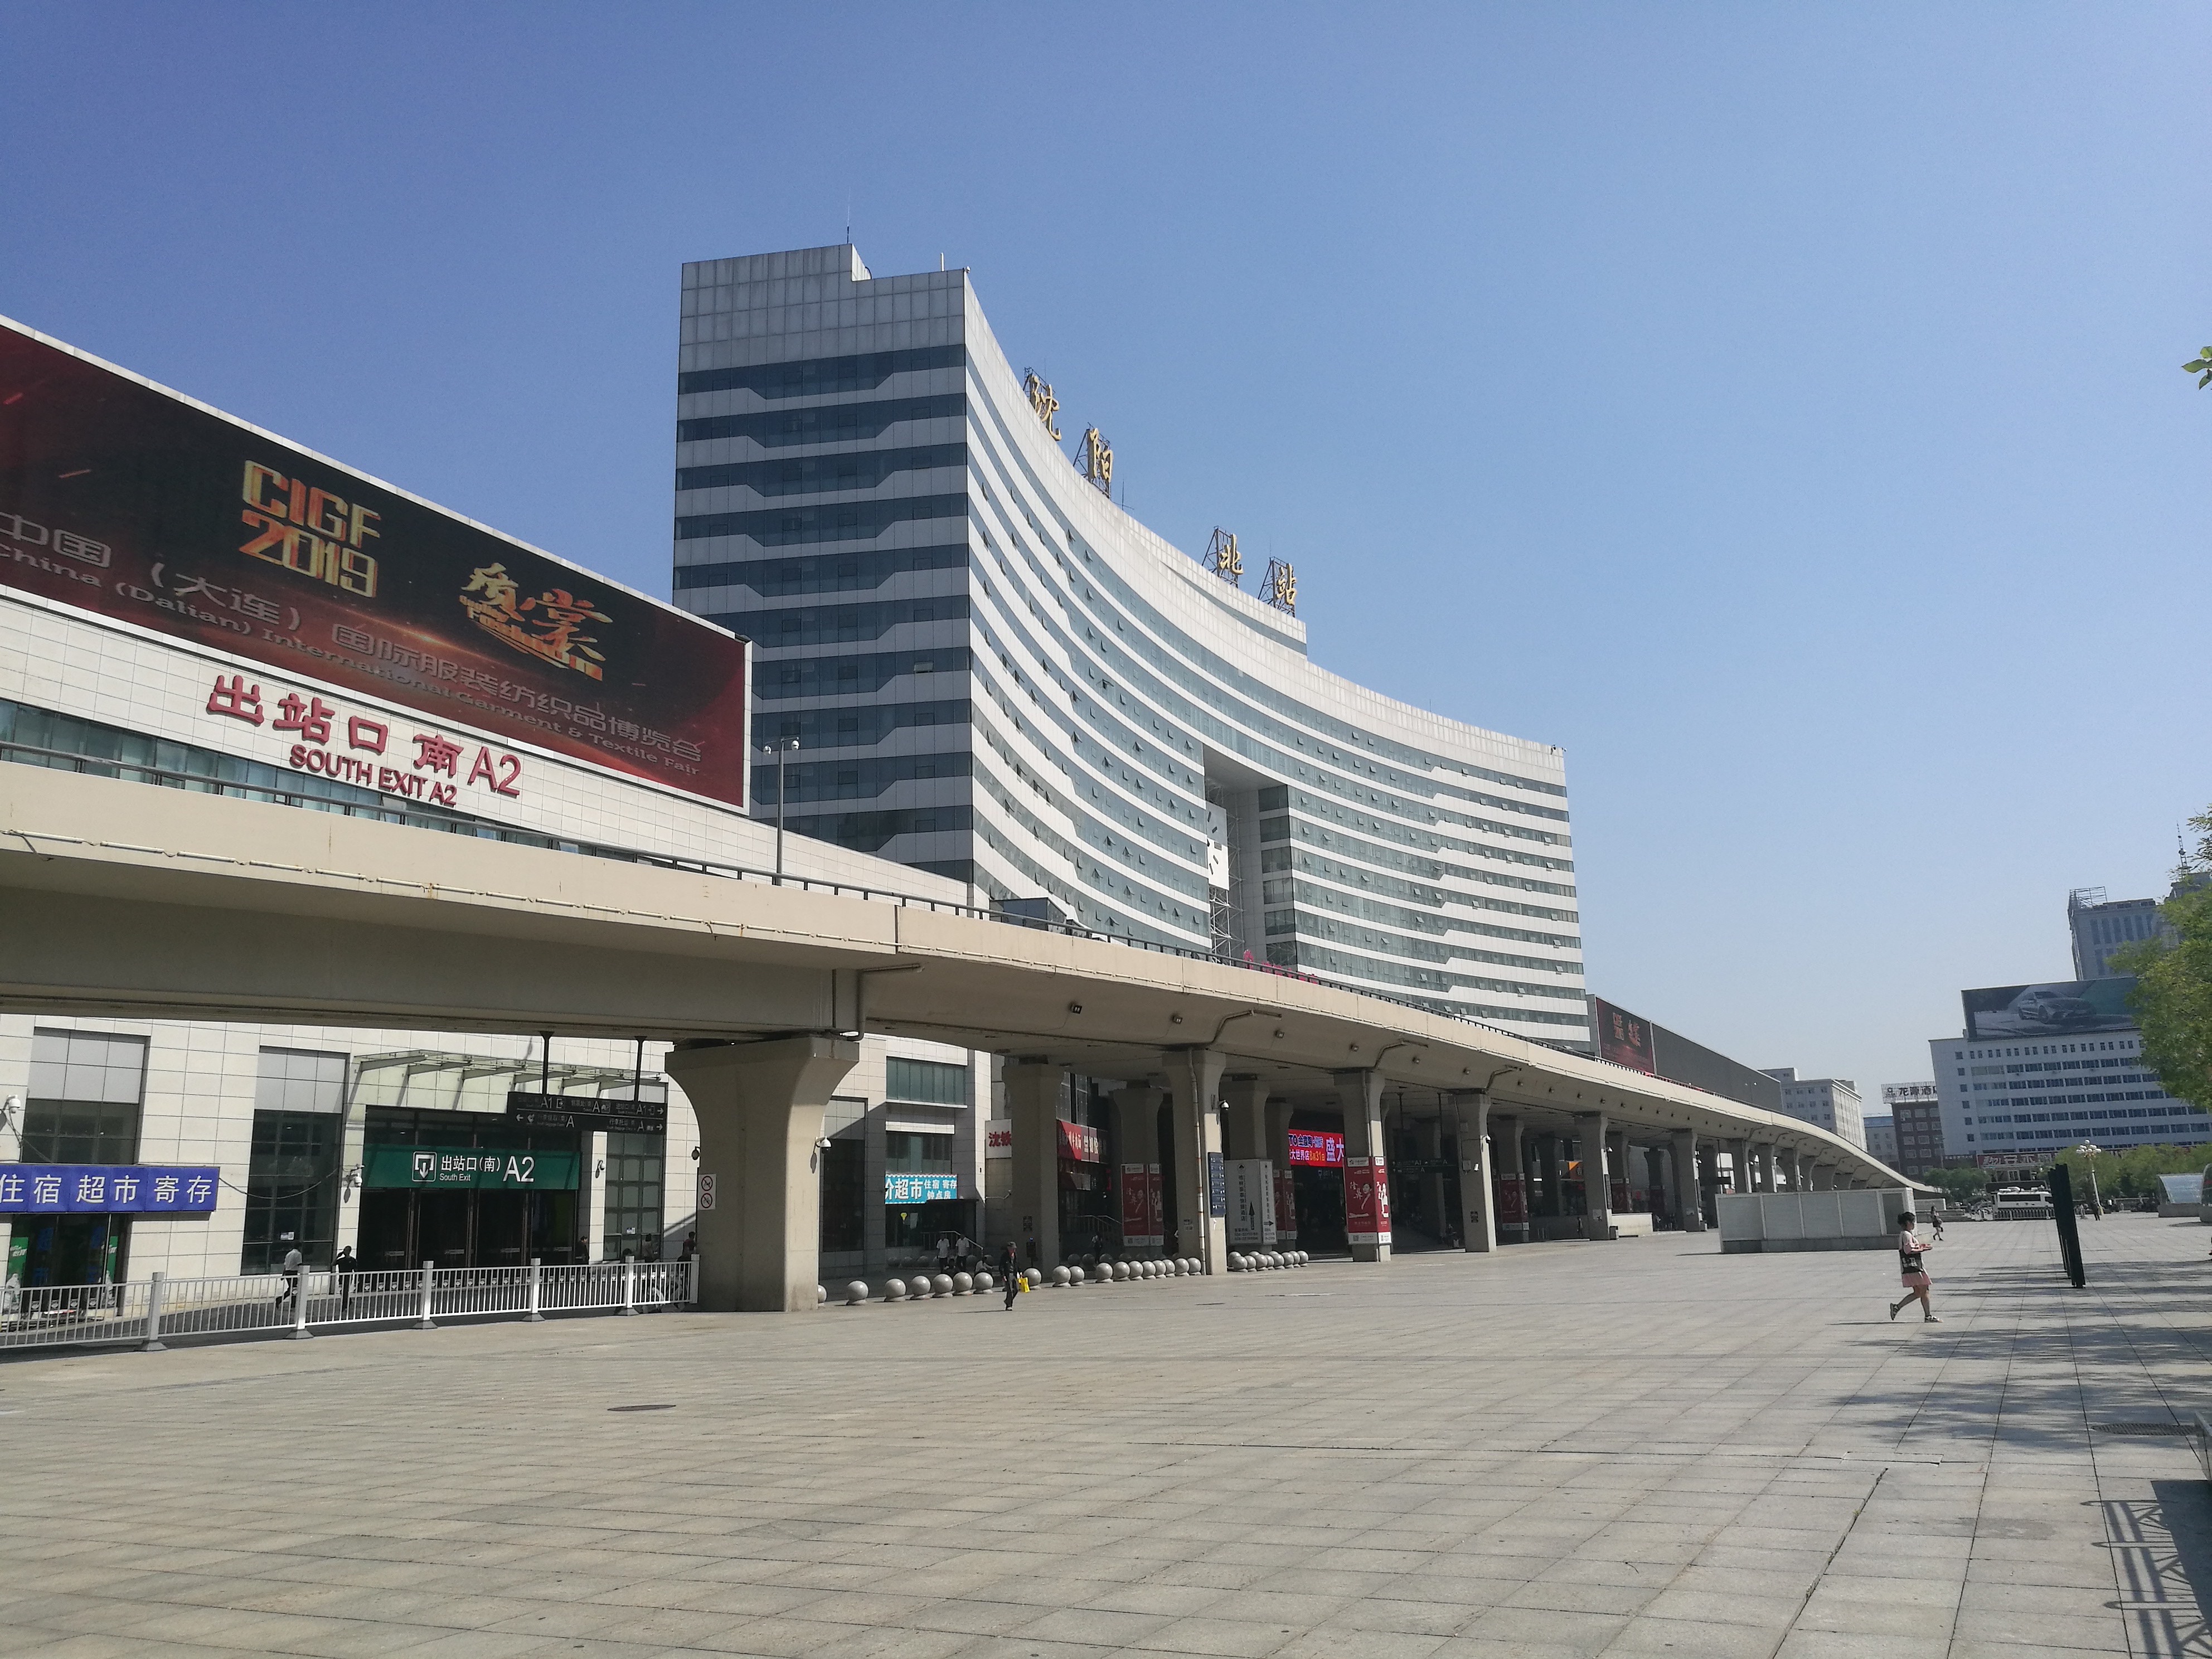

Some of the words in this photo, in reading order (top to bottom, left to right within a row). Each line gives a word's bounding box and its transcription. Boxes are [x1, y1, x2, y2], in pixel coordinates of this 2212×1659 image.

[242, 460, 381, 549] CIGF
[239, 509, 378, 598] 2019
[115, 582, 251, 636] (Dalian)
[261, 628, 450, 698] International
[456, 691, 562, 734] Garment
[588, 733, 658, 763] Textile
[664, 756, 700, 776] Fair
[290, 744, 372, 783] SOUTH
[379, 768, 428, 796] EXIT
[430, 784, 456, 806] A2
[0, 1173, 62, 1204] 住宿
[76, 1174, 140, 1204] 超市
[153, 1175, 213, 1204] 寄存
[439, 1173, 458, 1181] South
[441, 1154, 501, 1172] 出站口(南)
[503, 1156, 535, 1182] A2
